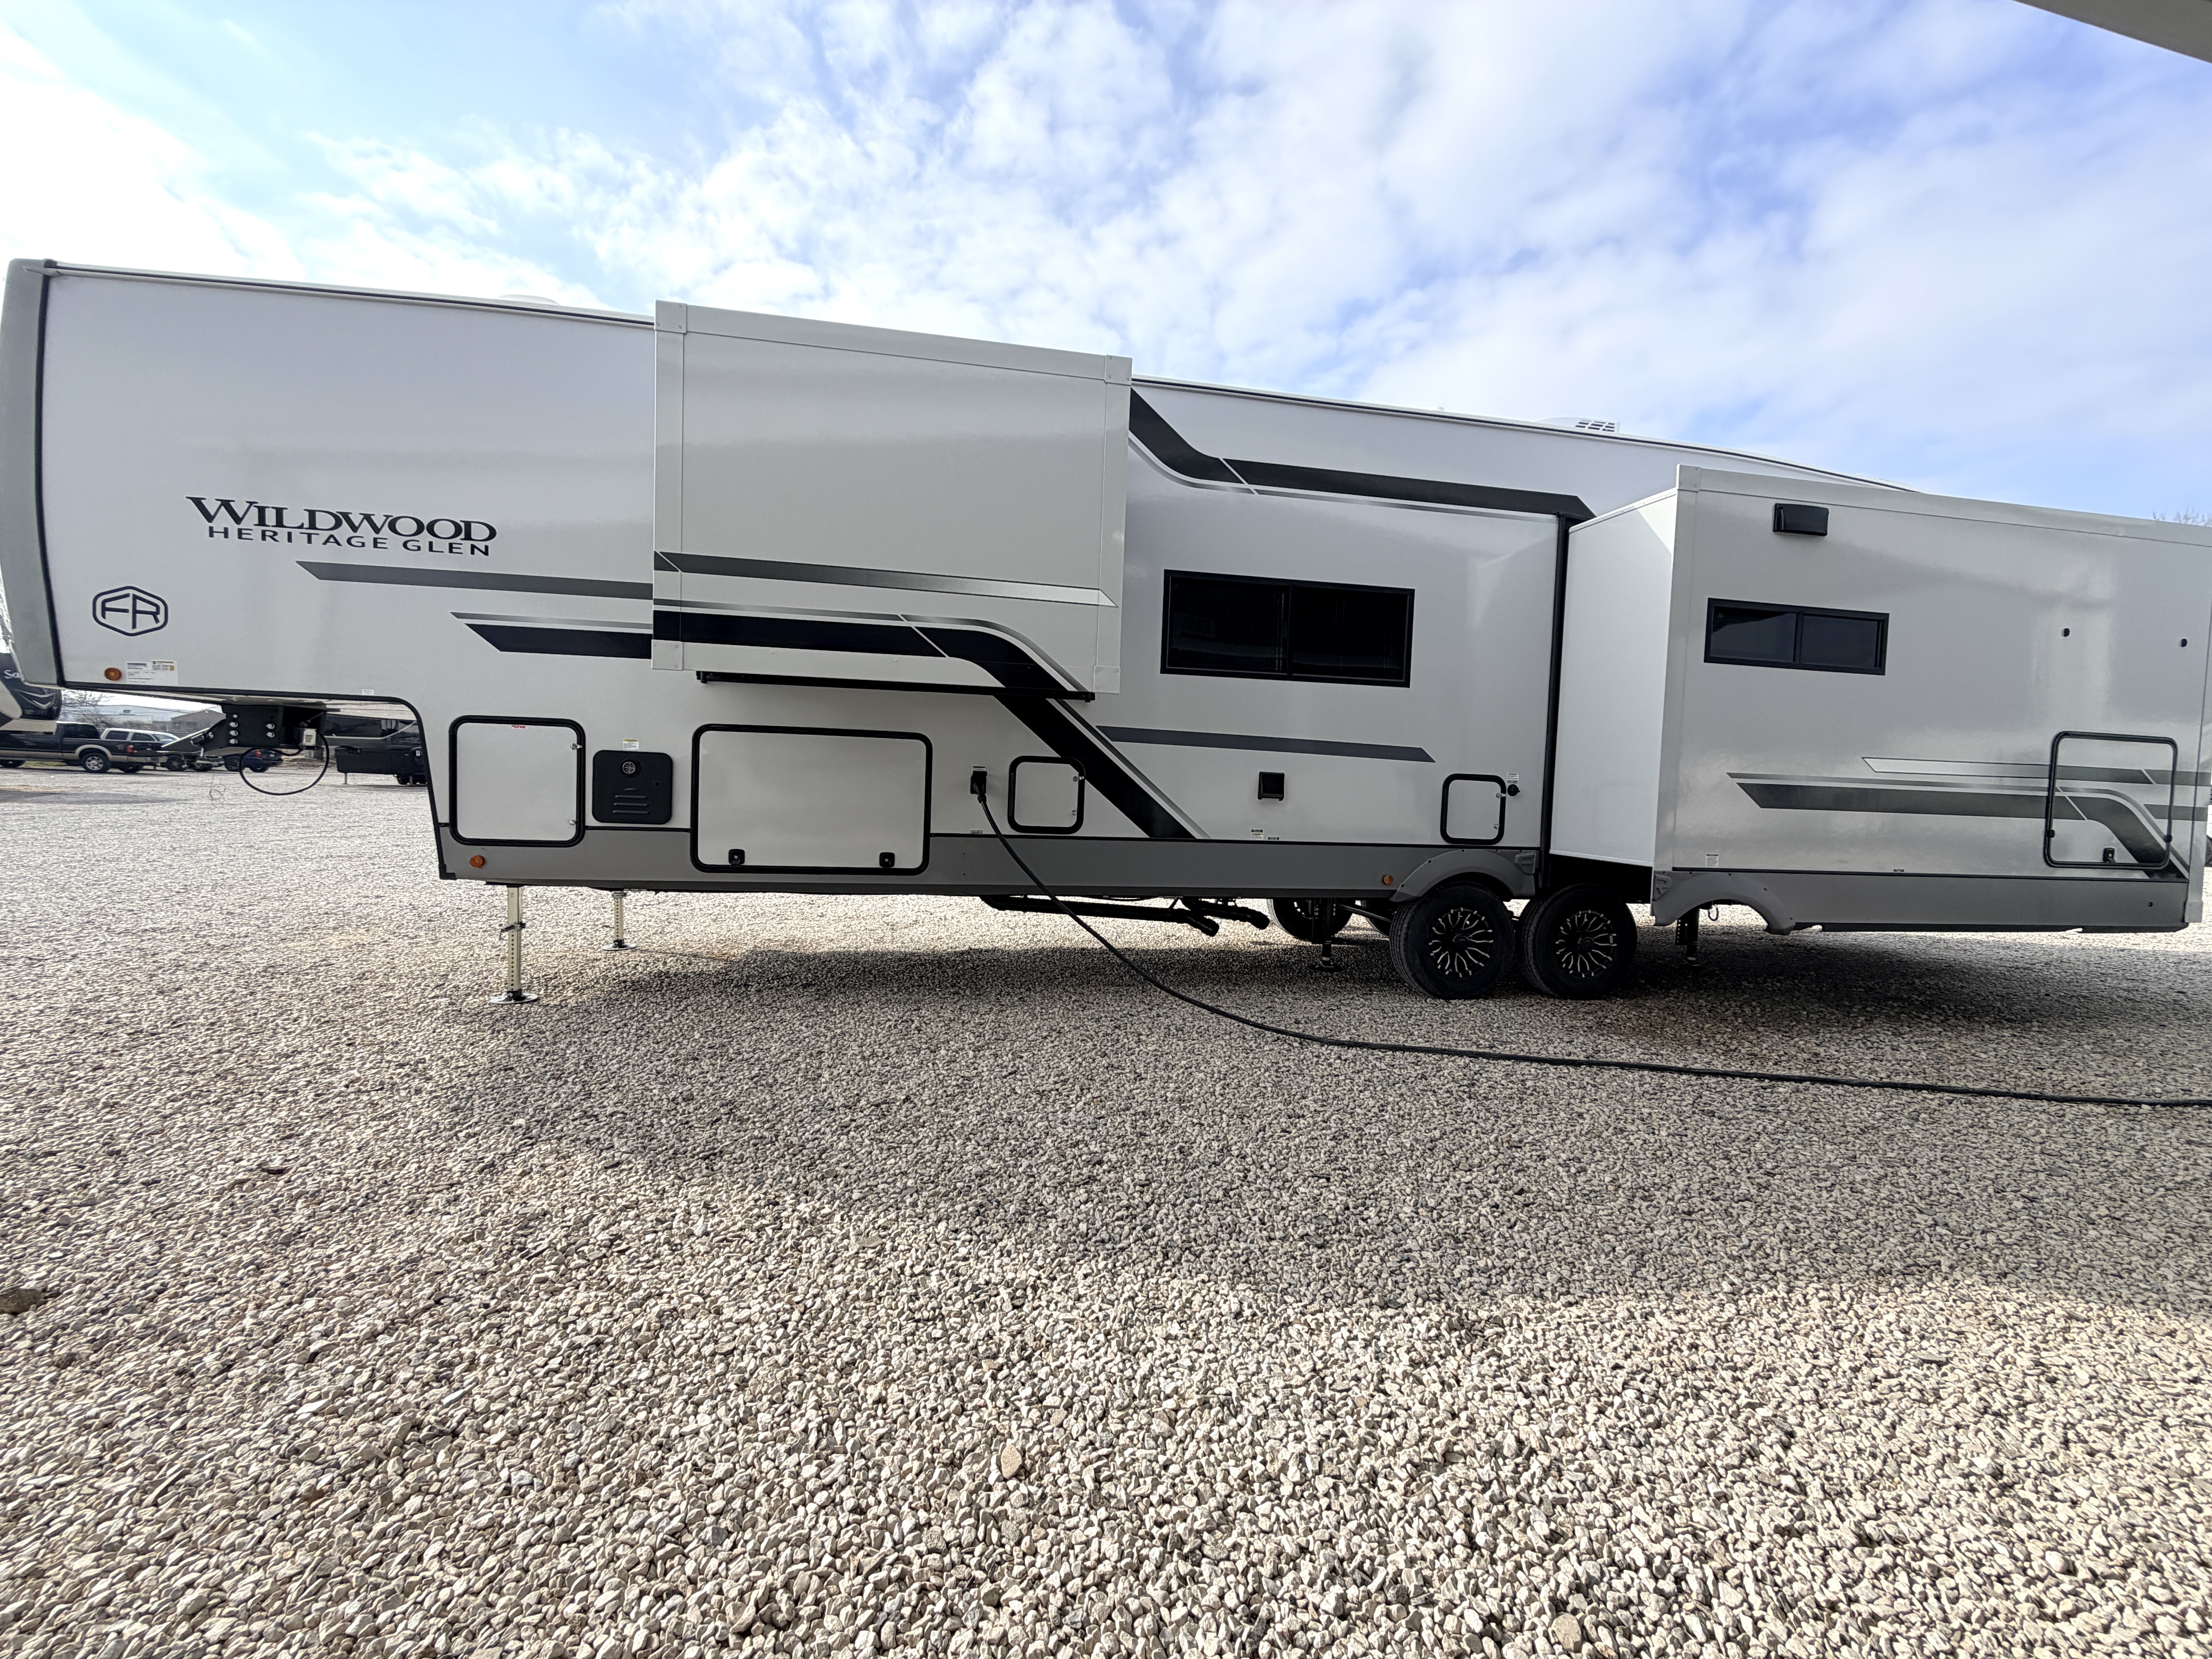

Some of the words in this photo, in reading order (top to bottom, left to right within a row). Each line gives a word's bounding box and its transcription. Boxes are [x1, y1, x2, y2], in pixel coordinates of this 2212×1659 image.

[209, 526, 388, 550] HERITAGE
[402, 539, 489, 556] GLEN
[101, 593, 160, 630] FR
